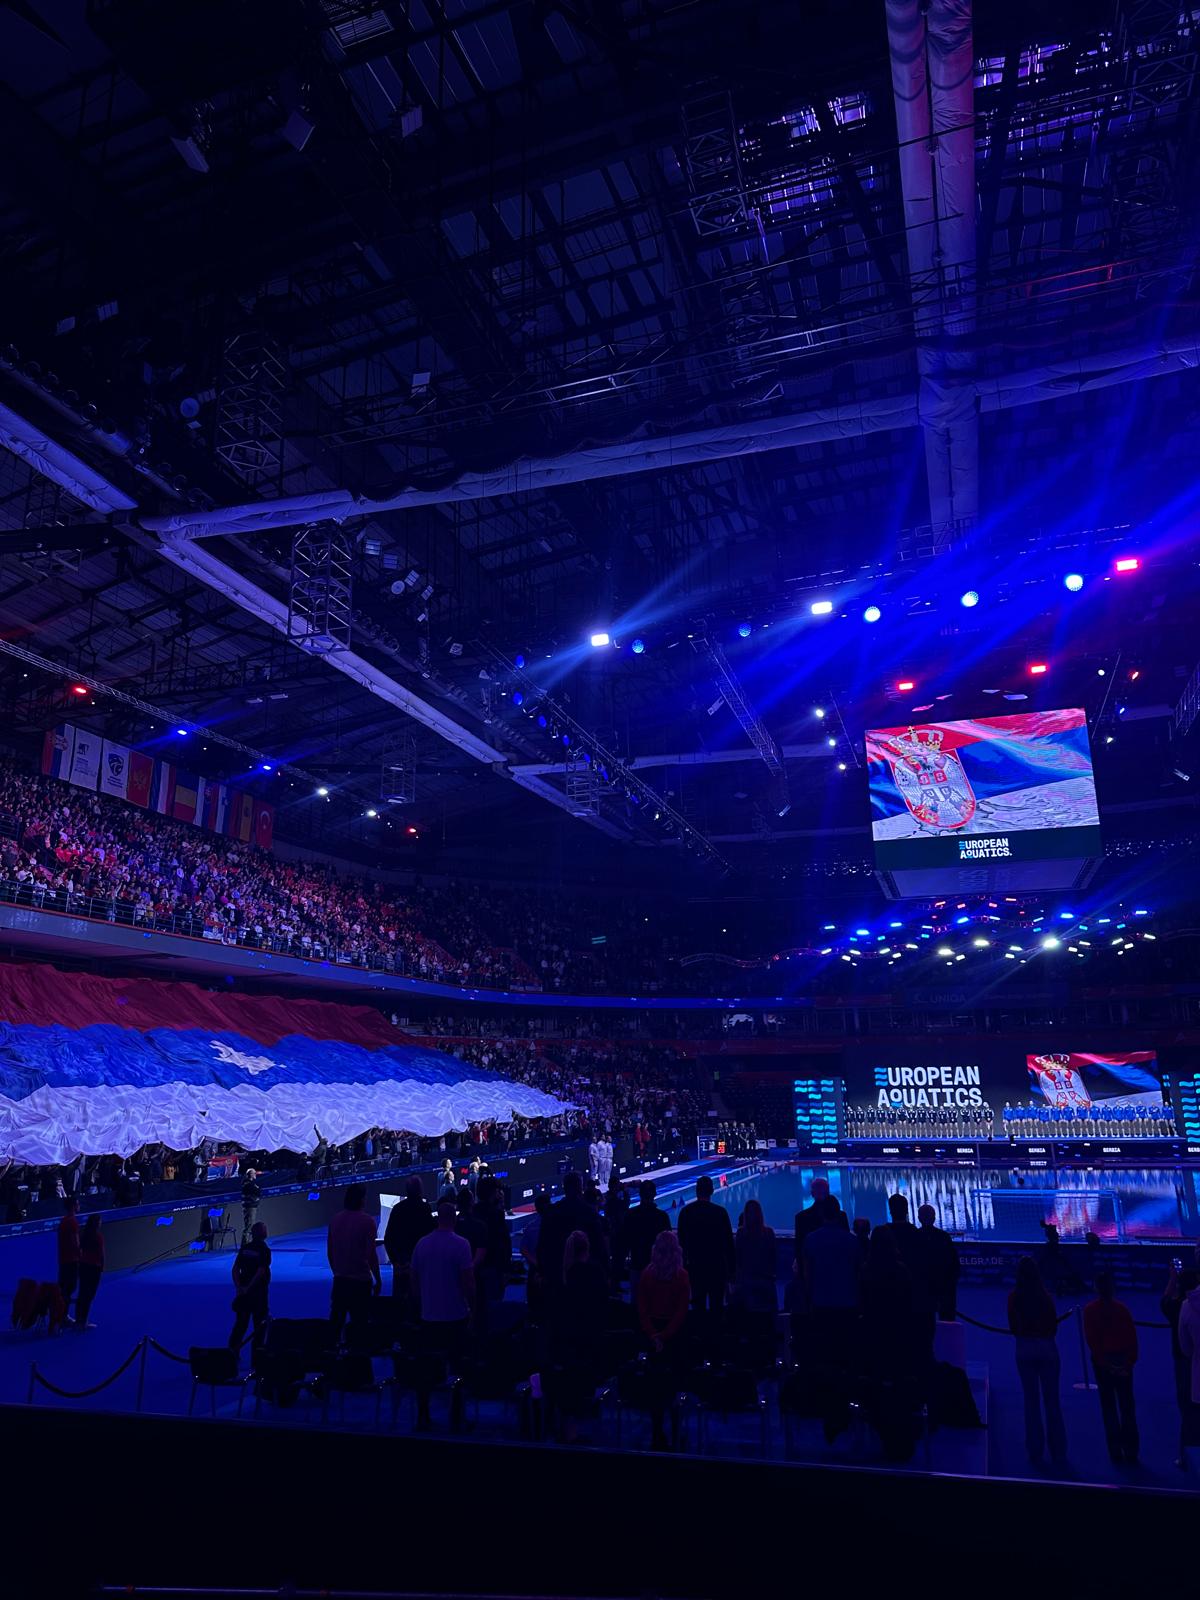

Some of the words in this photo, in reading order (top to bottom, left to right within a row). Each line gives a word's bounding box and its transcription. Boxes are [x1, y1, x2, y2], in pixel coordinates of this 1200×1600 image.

[958, 838, 1009, 850] EUROPEAN
[874, 1066, 981, 1086] EUROPEAN
[959, 1256, 1005, 1265] ELGRADE
